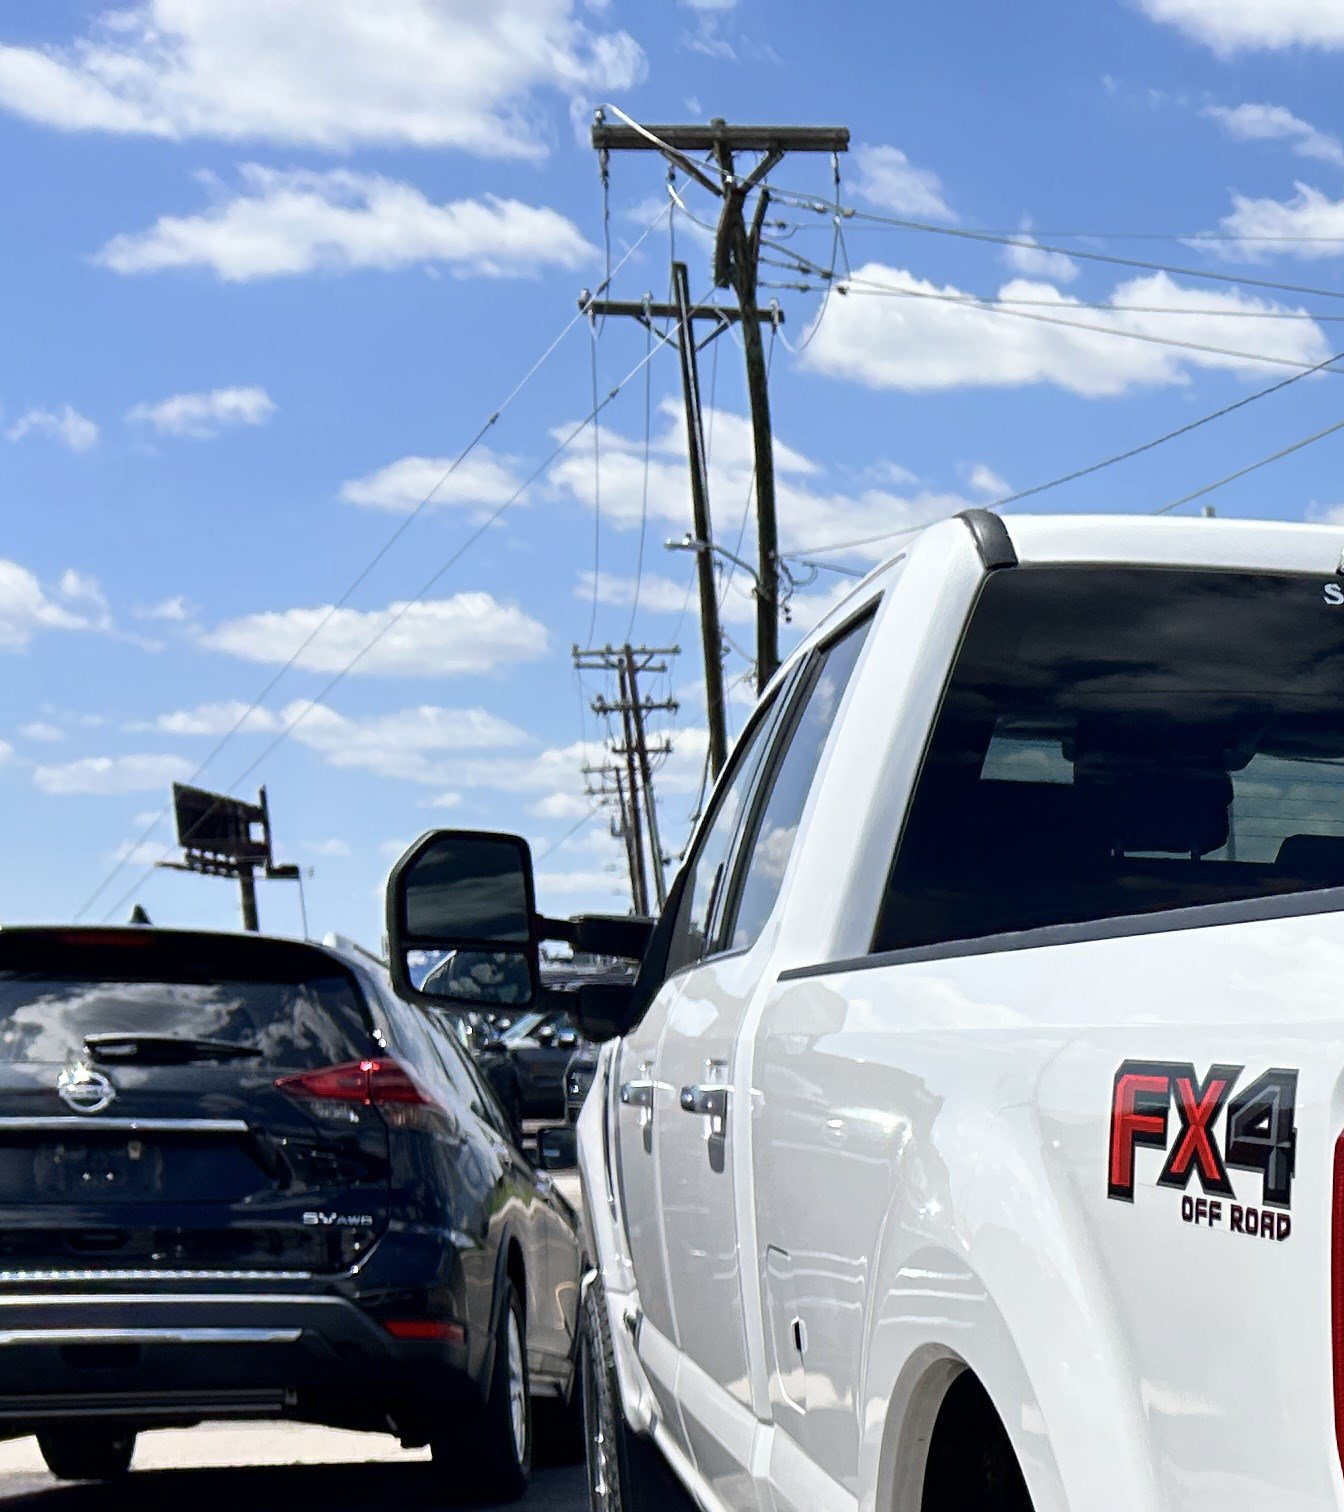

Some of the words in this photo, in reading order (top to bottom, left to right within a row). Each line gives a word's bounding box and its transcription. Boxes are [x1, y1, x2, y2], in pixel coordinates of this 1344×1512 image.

[1107, 1058, 1299, 1211] FX4
[1181, 1195, 1222, 1228] OFF
[1230, 1203, 1292, 1242] ROAD
